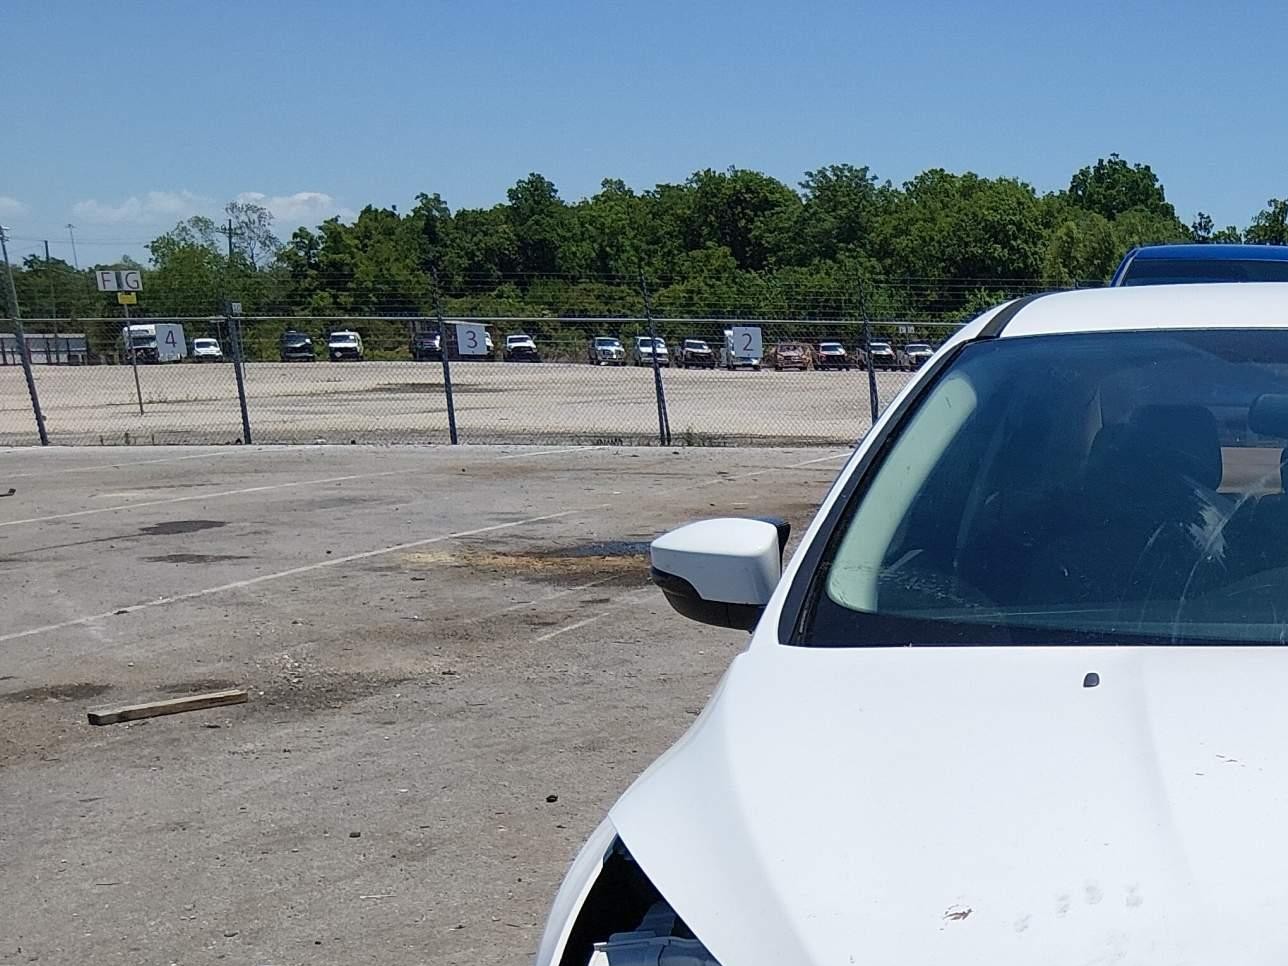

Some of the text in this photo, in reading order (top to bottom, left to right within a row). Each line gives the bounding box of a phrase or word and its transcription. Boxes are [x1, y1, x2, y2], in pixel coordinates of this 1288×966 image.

[101, 272, 139, 289] F G
[165, 330, 176, 348] 4
[465, 330, 478, 349] 3
[742, 333, 754, 352] 2
